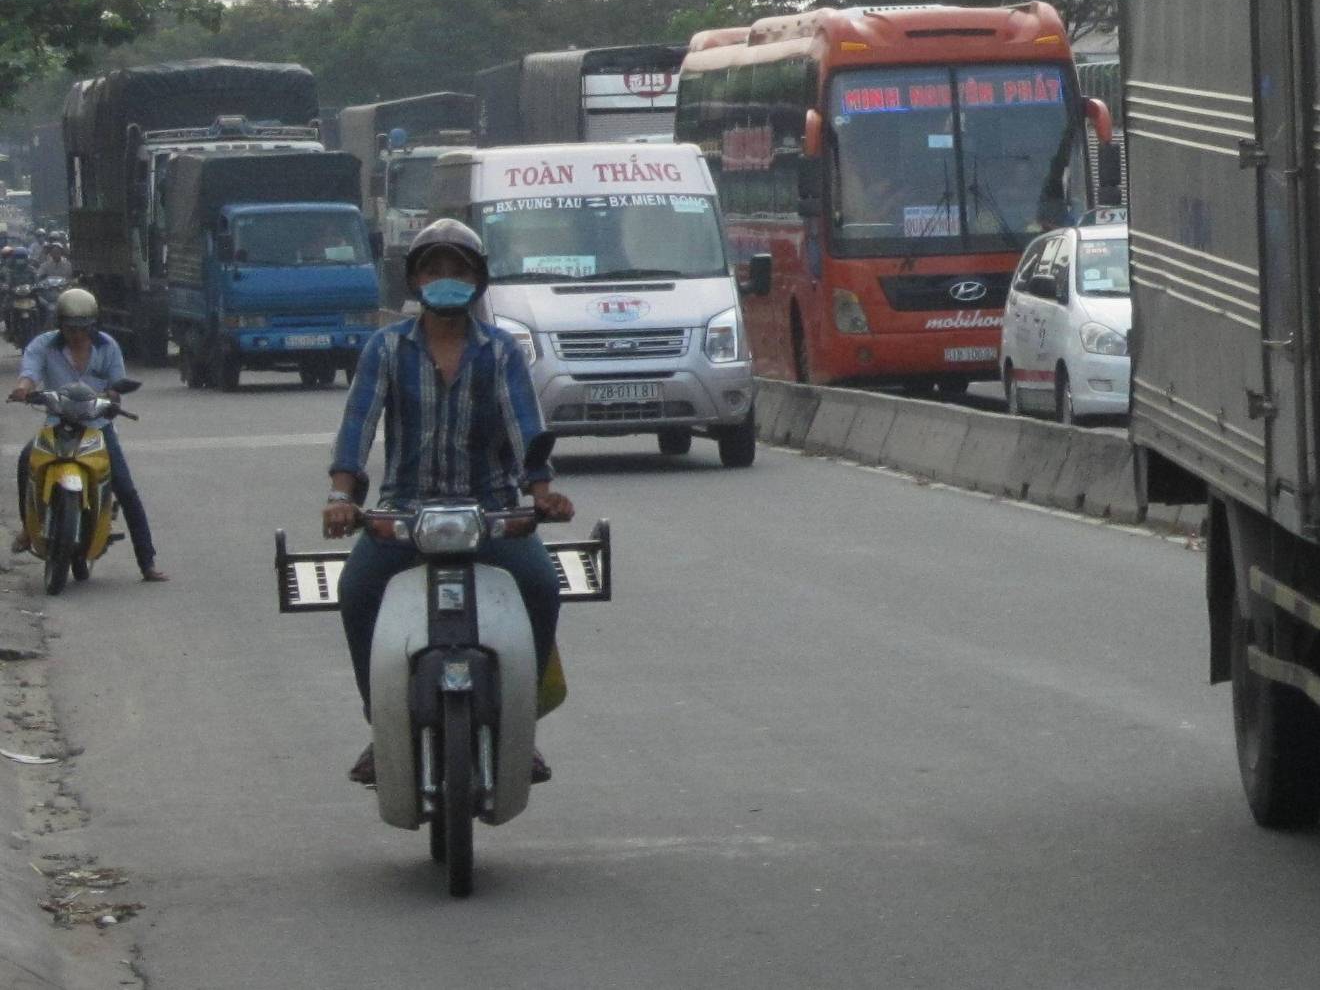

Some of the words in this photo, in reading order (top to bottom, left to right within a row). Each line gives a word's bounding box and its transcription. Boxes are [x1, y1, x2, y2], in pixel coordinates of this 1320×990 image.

[846, 87, 899, 110] MINH
[909, 78, 994, 107] NGUÊN
[505, 161, 574, 187] TOÀN
[593, 153, 682, 183] THẮNG
